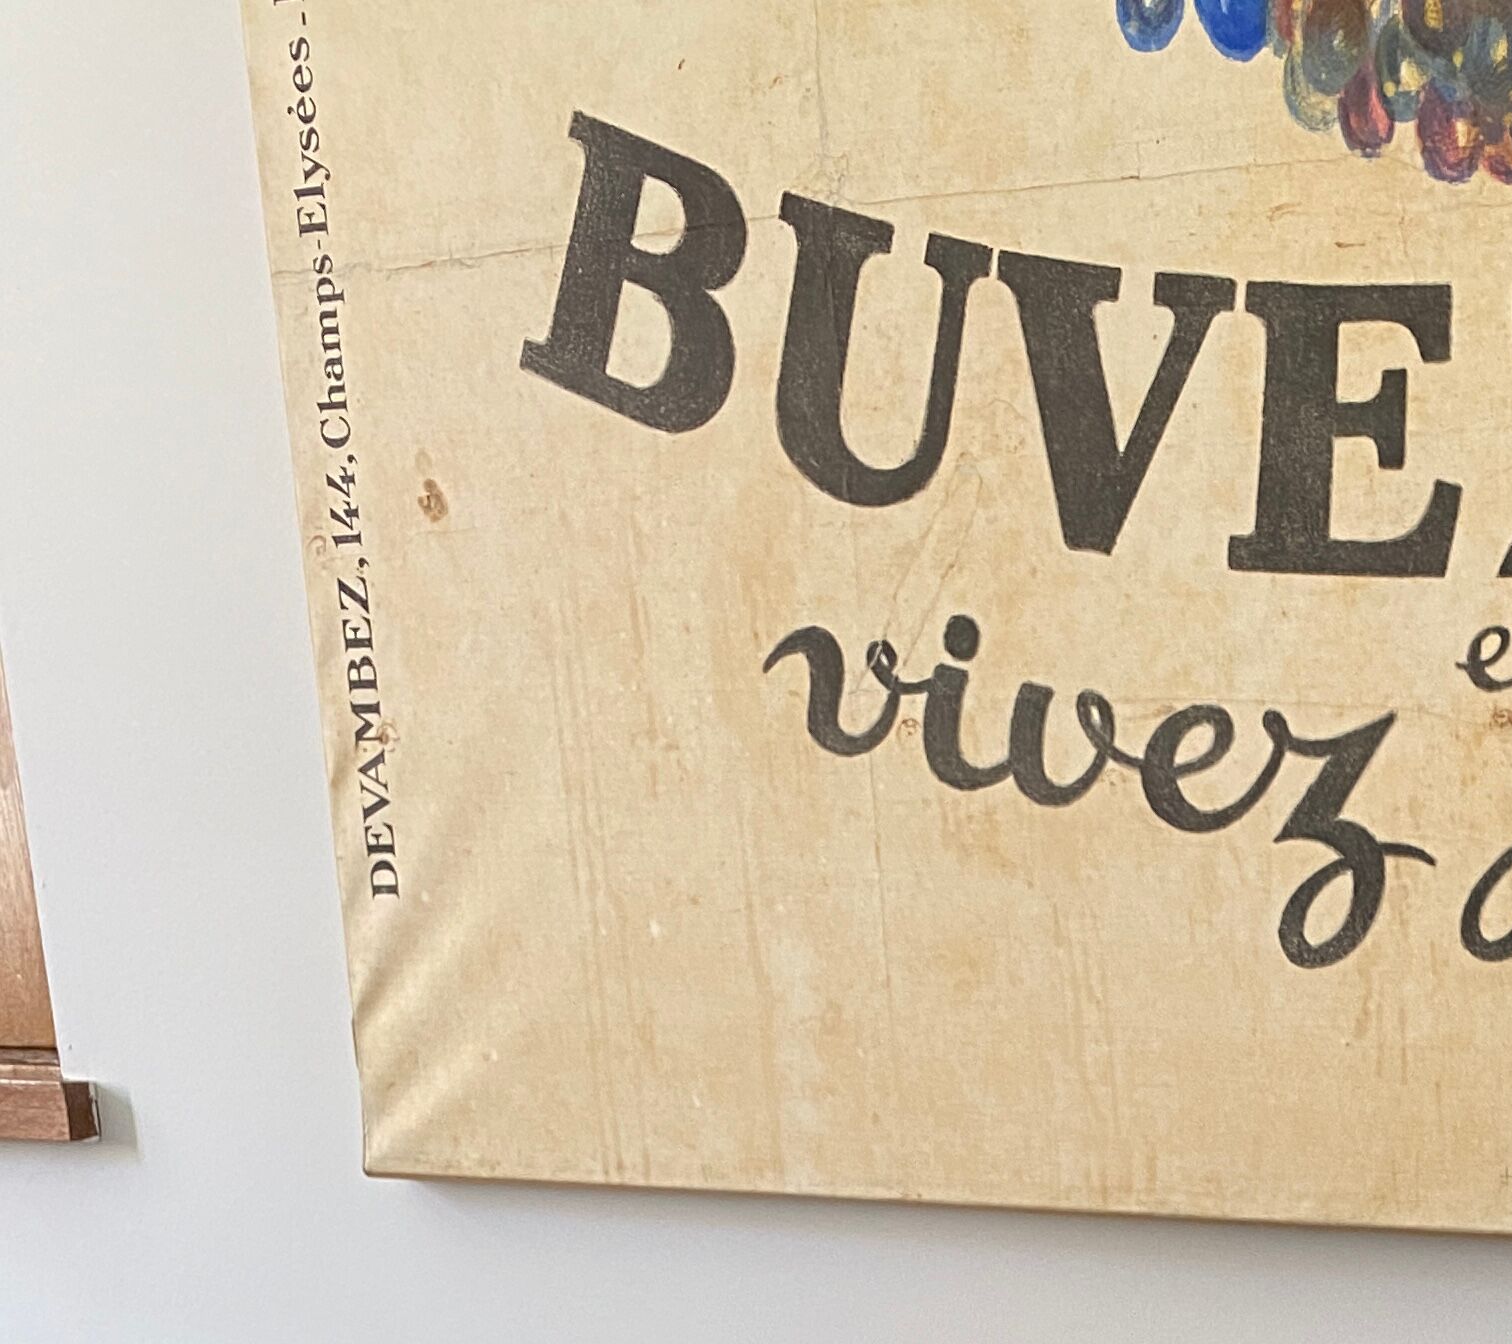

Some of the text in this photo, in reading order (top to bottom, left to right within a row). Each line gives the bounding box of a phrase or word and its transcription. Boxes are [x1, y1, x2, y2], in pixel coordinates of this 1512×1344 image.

[325, 454, 363, 549] 144,
[336, 557, 400, 900] DEVAMBEZ,
[762, 614, 1437, 969] vivez
